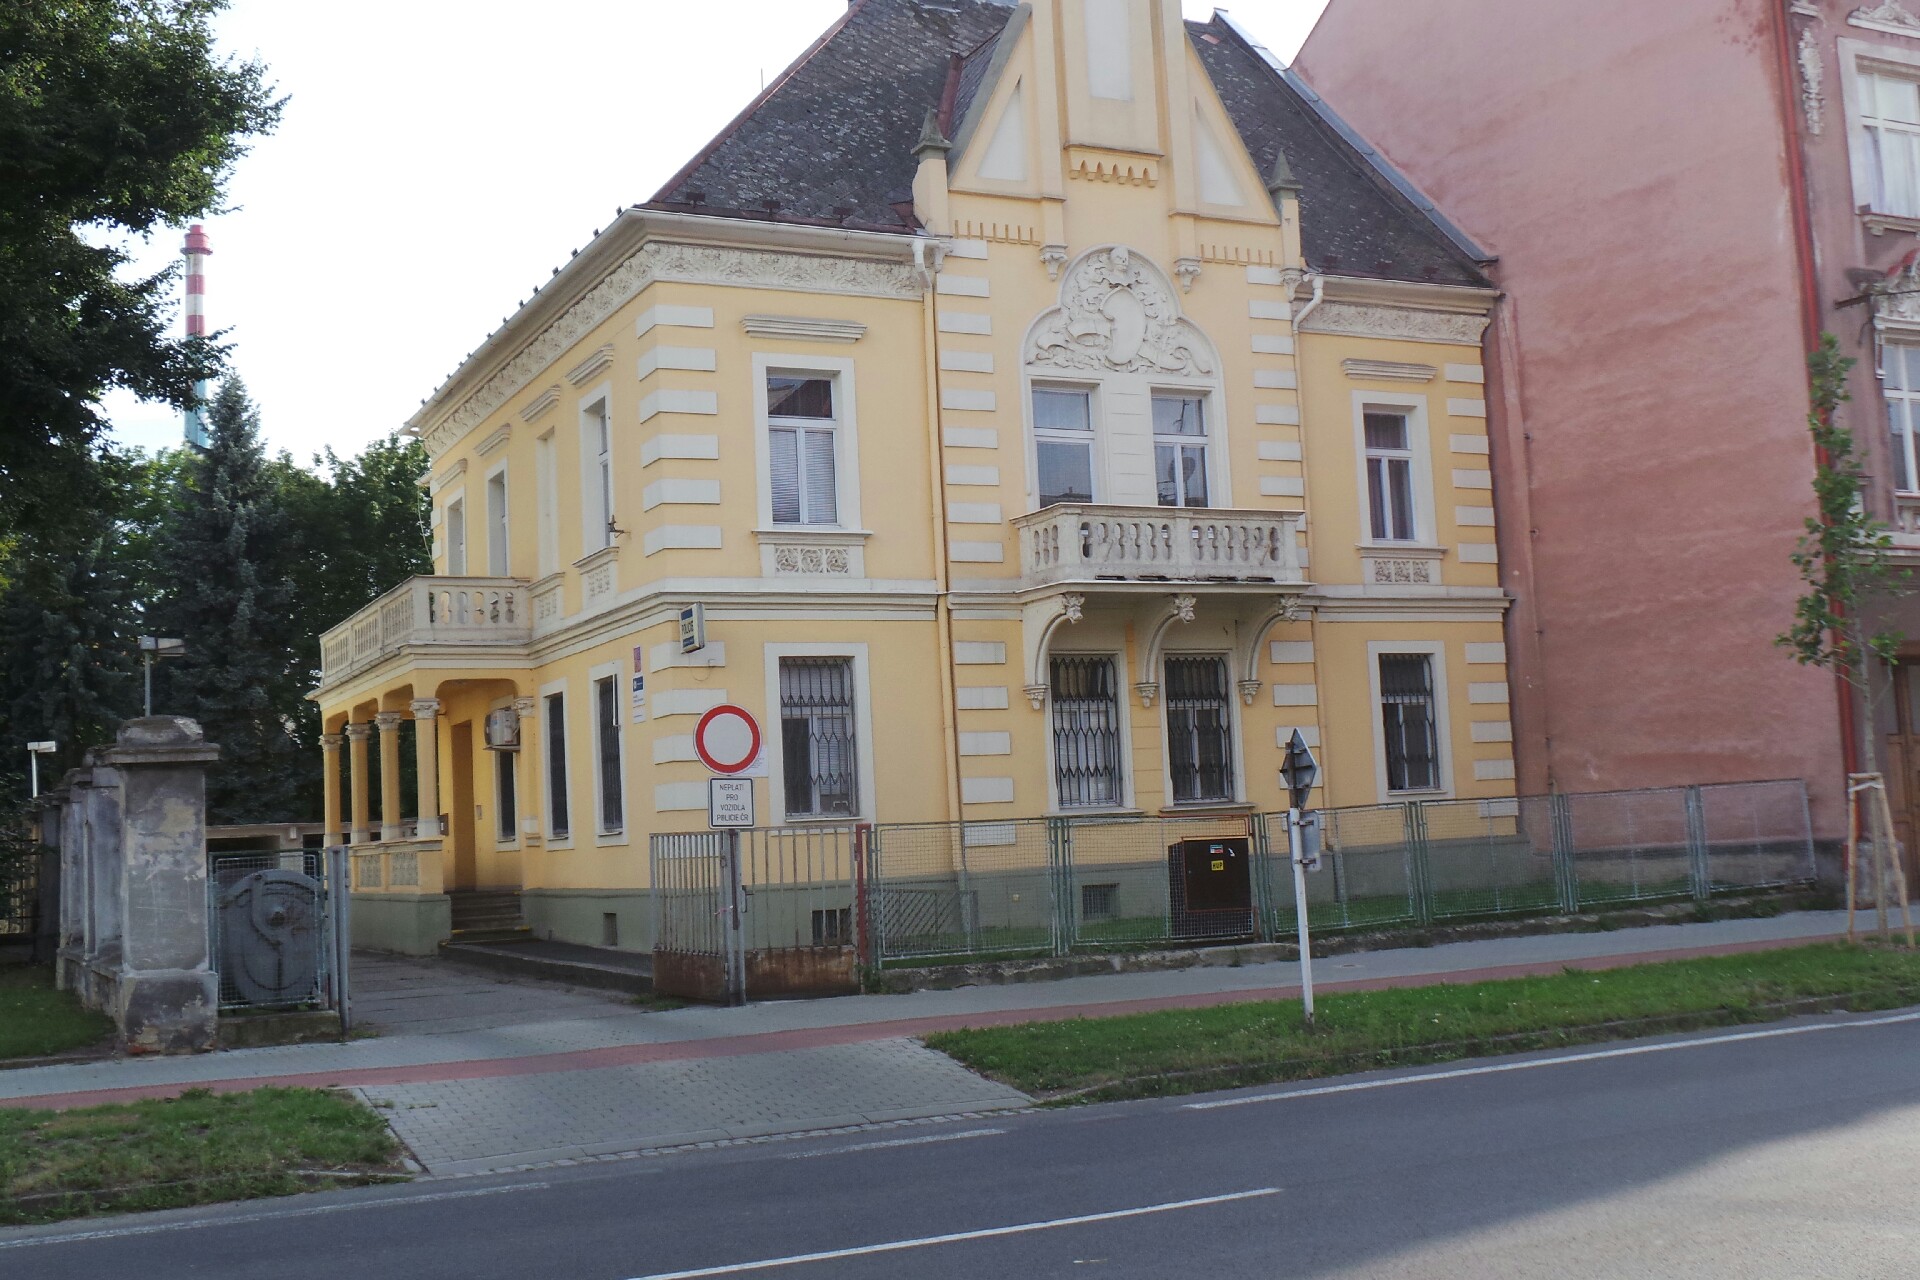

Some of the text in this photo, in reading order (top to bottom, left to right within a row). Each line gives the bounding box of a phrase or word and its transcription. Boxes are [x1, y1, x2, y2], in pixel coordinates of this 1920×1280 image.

[726, 793, 739, 801] PRO
[720, 803, 746, 811] VOZIDLA
[716, 812, 749, 821] POLICIE ČR
